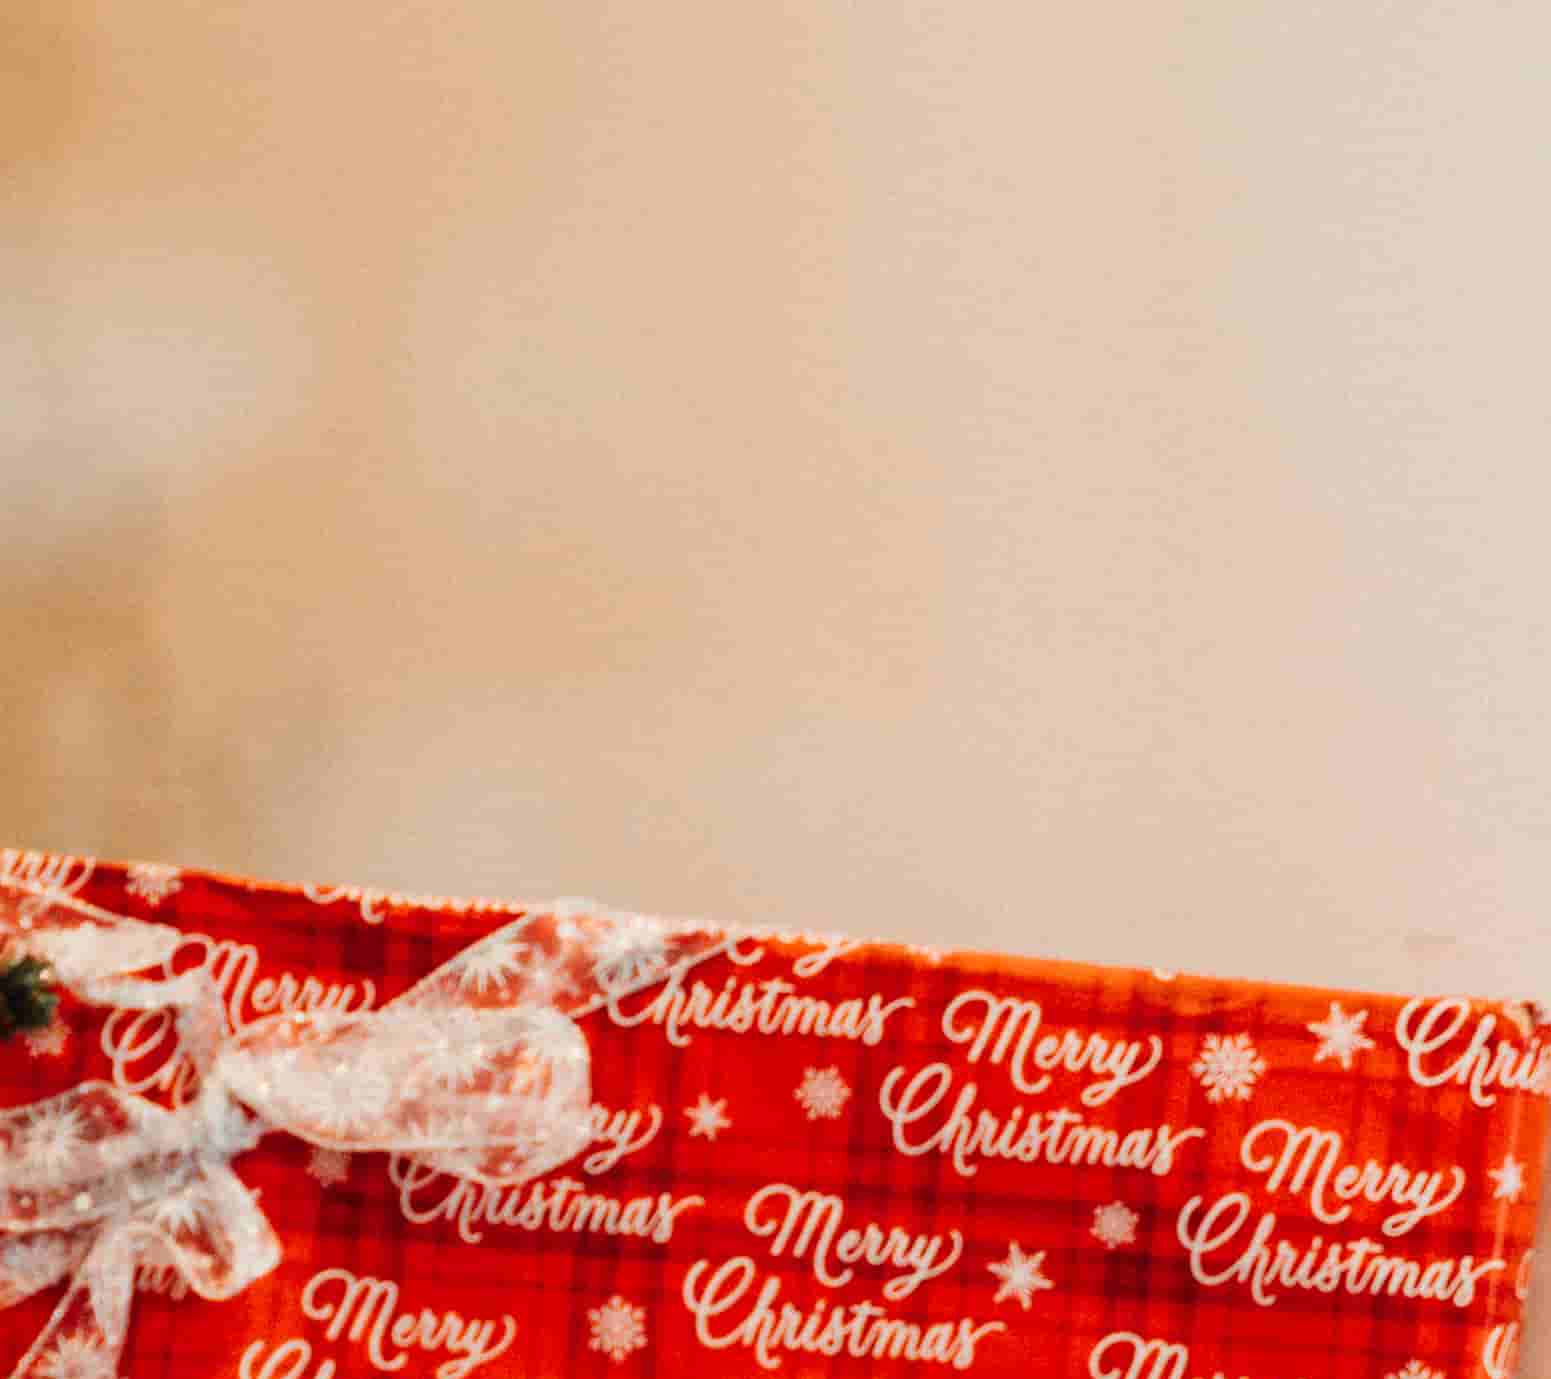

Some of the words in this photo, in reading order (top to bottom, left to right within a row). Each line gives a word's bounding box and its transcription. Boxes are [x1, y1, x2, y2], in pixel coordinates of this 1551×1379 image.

[943, 989, 1163, 1106] Merry
[879, 1062, 1205, 1176] Christmas
[1240, 1119, 1464, 1236] Merry
[744, 1183, 963, 1299] Merry
[1177, 1192, 1506, 1307] Christmas
[682, 1256, 1007, 1369] Christmas
